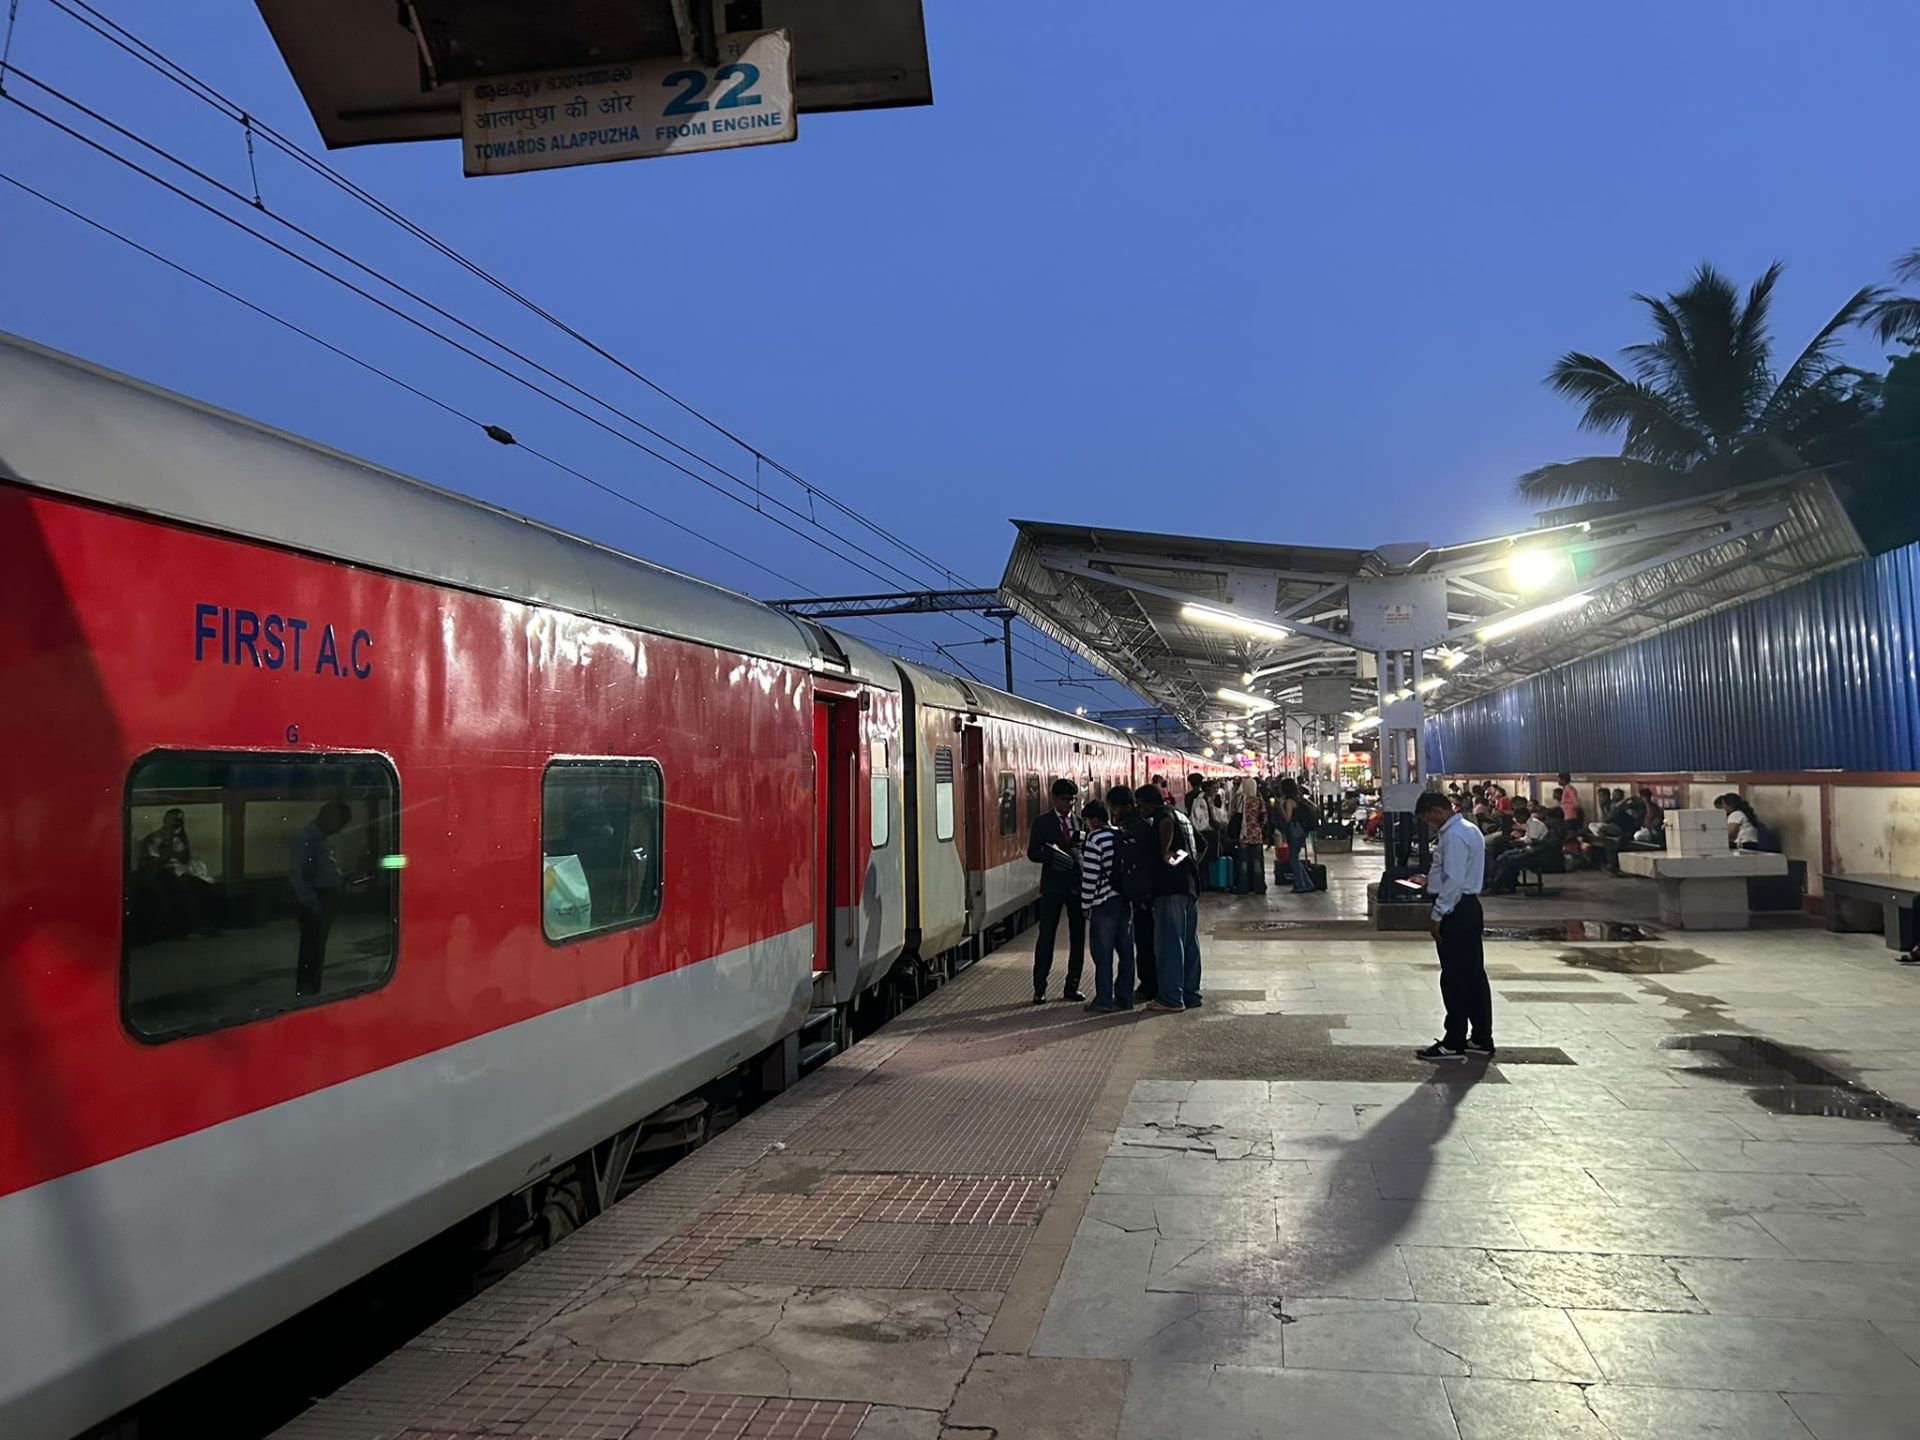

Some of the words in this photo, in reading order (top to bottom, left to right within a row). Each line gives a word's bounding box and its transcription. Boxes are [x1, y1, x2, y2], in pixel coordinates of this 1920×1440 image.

[565, 95, 589, 120] की
[599, 91, 635, 115] ओर
[662, 63, 763, 117] 22
[475, 136, 547, 160] TOWARDS
[551, 125, 640, 151] ALAPPUZHA
[655, 122, 707, 141] FROM
[713, 112, 782, 133] ENGINE
[195, 603, 307, 672] FIRST
[315, 623, 373, 680] A.C
[286, 724, 299, 744] G
